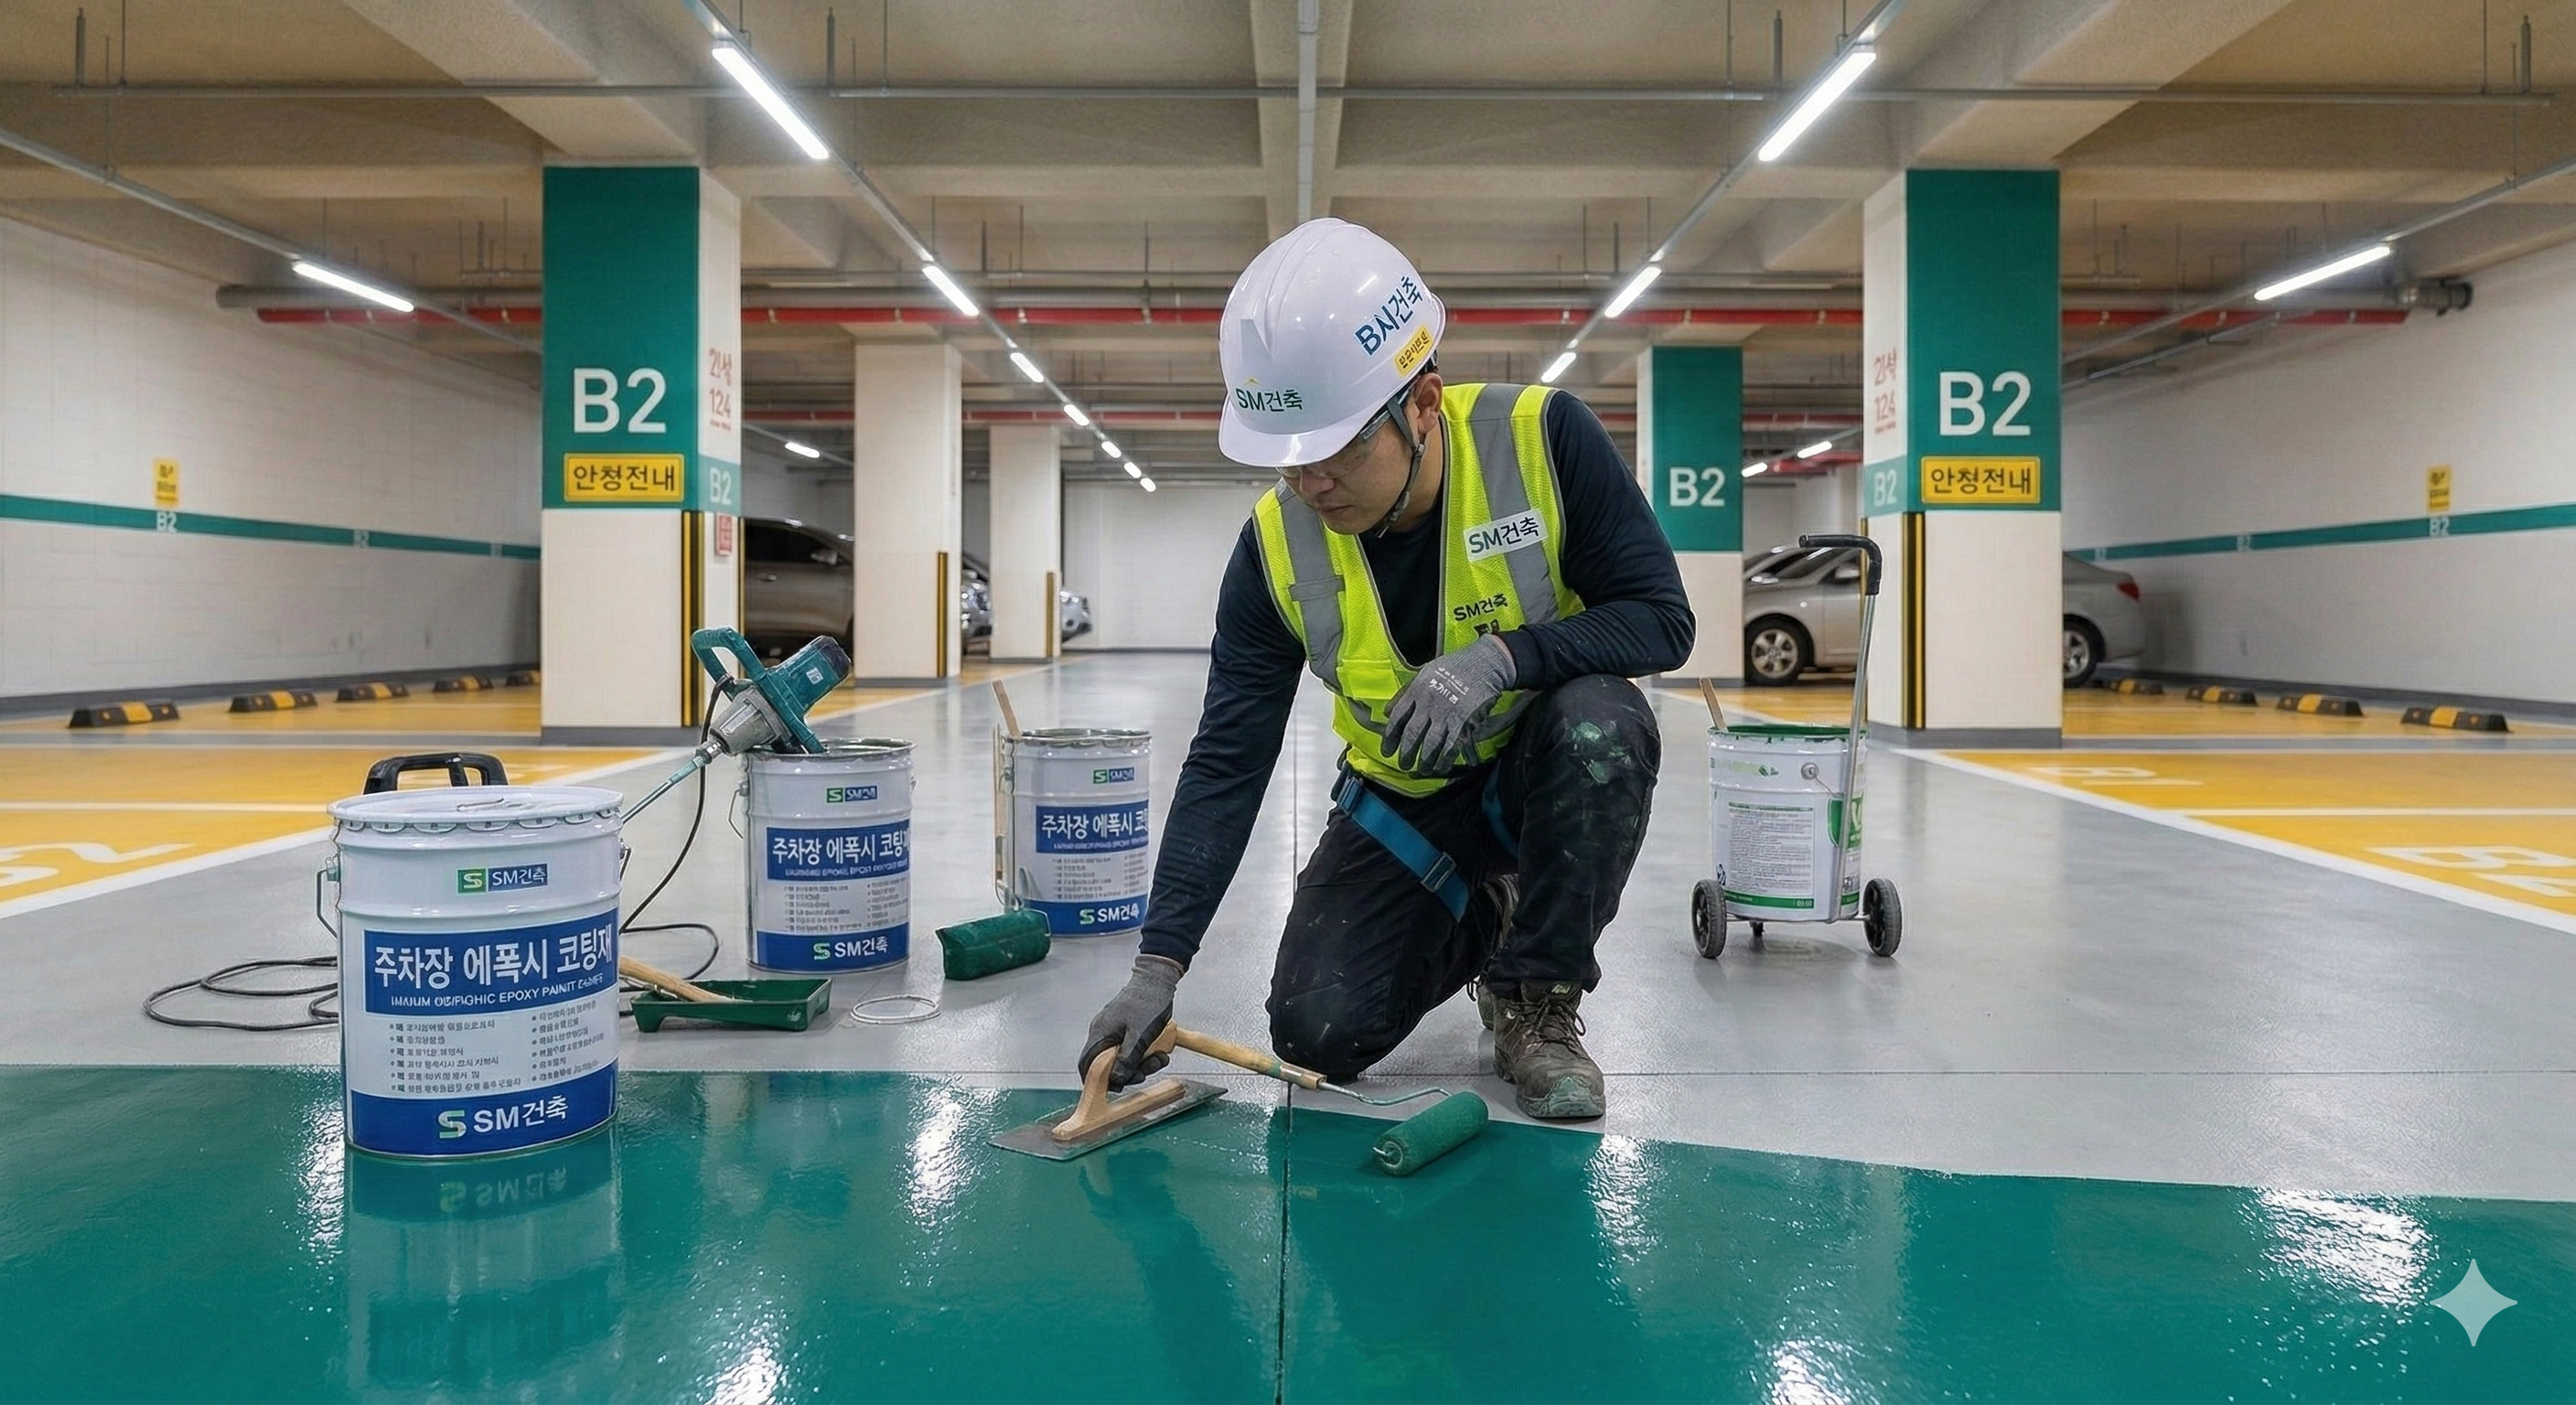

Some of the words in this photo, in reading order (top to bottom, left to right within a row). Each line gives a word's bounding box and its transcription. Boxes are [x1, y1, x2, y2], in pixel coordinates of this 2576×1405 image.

[574, 368, 667, 434] B2
[1236, 388, 1303, 413] SM건축
[1939, 370, 2032, 436] B2
[709, 467, 732, 505] B2
[1669, 467, 1725, 507] B2
[1873, 468, 1897, 508] B2
[156, 510, 177, 533] B2
[1468, 517, 1540, 553] SM건축
[2429, 516, 2450, 537] B2
[1042, 814, 1089, 840] 주차장
[772, 837, 822, 866] 주차장
[826, 833, 875, 864] 에폭시
[373, 947, 454, 990] 주차장
[463, 938, 548, 986] 에폭시
[556, 923, 613, 973] 코팅재
[499, 987, 540, 1003] EPOXY
[473, 1094, 569, 1133] SM건축
